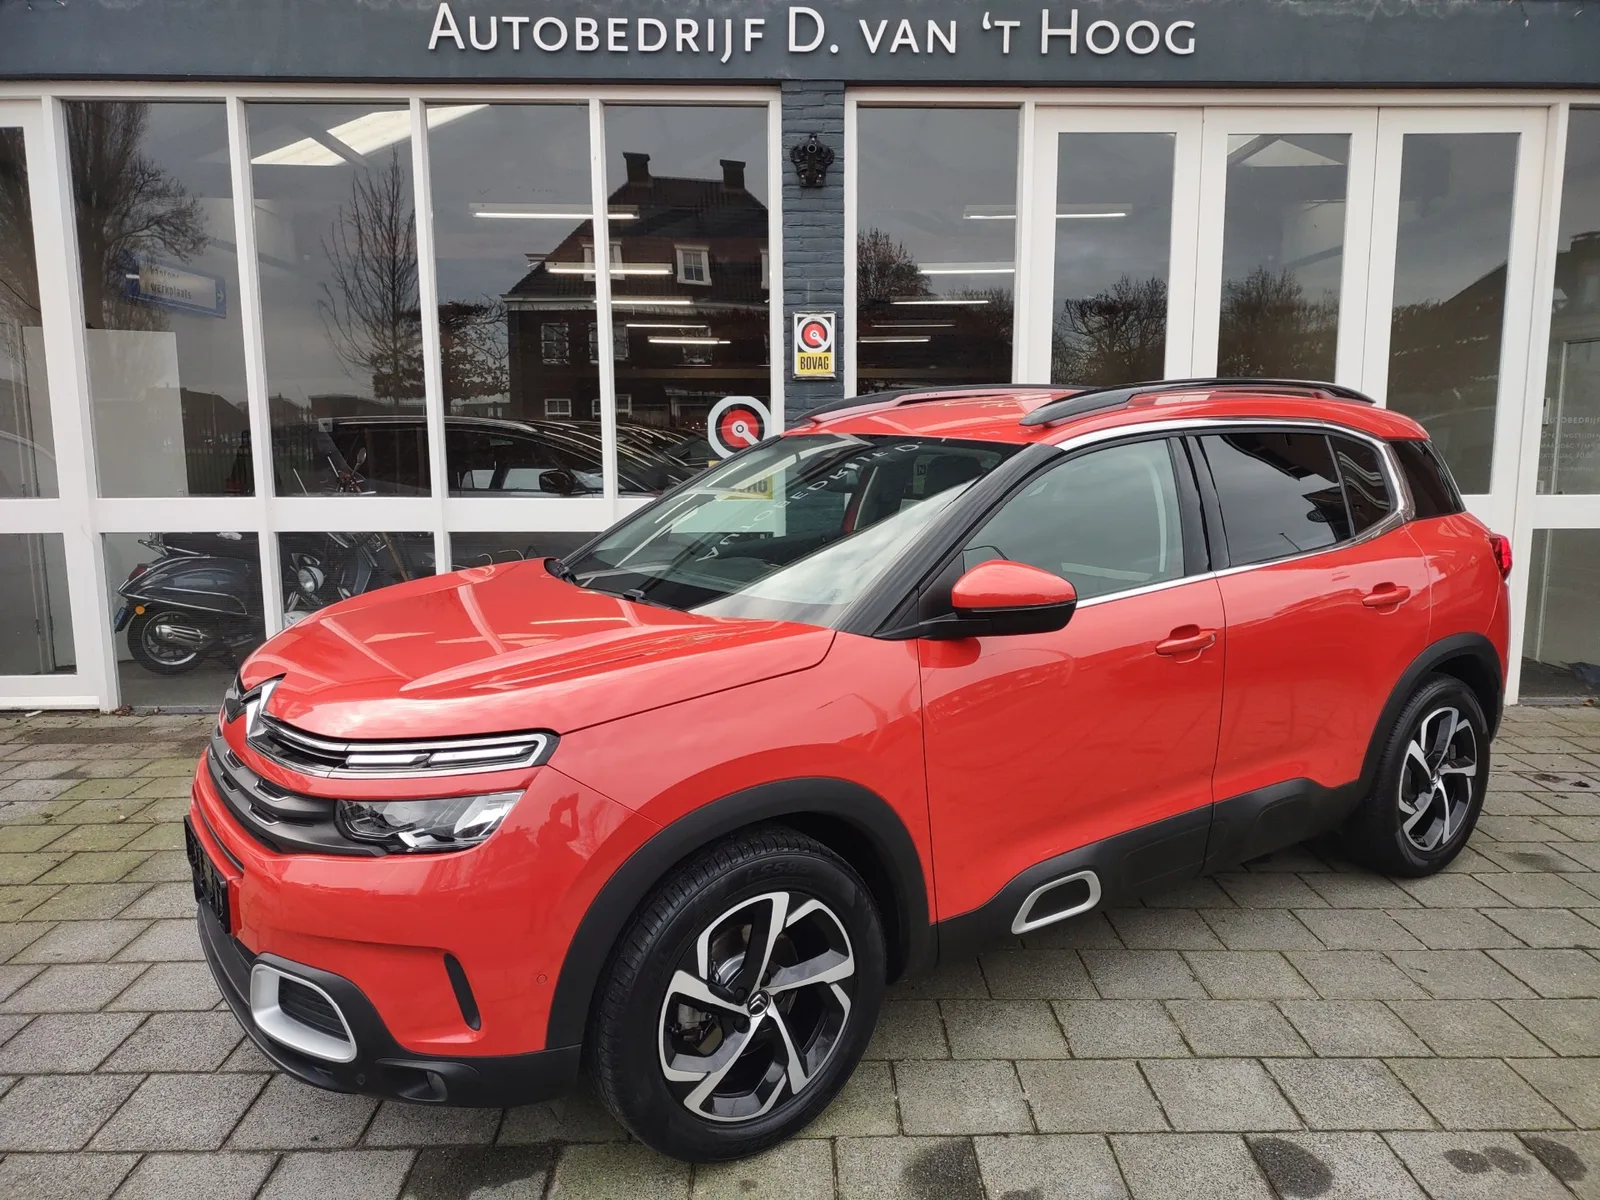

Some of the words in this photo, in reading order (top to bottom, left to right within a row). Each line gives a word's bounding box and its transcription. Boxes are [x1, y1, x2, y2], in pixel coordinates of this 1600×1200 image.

[428, 3, 765, 63] AUTOBEDRIJF
[788, 6, 839, 53] D.
[859, 19, 957, 54] VAN
[1041, 9, 1196, 55] HOOG
[800, 356, 829, 370] BOVAG
[1543, 416, 1600, 425] UTOBEDRIJF
